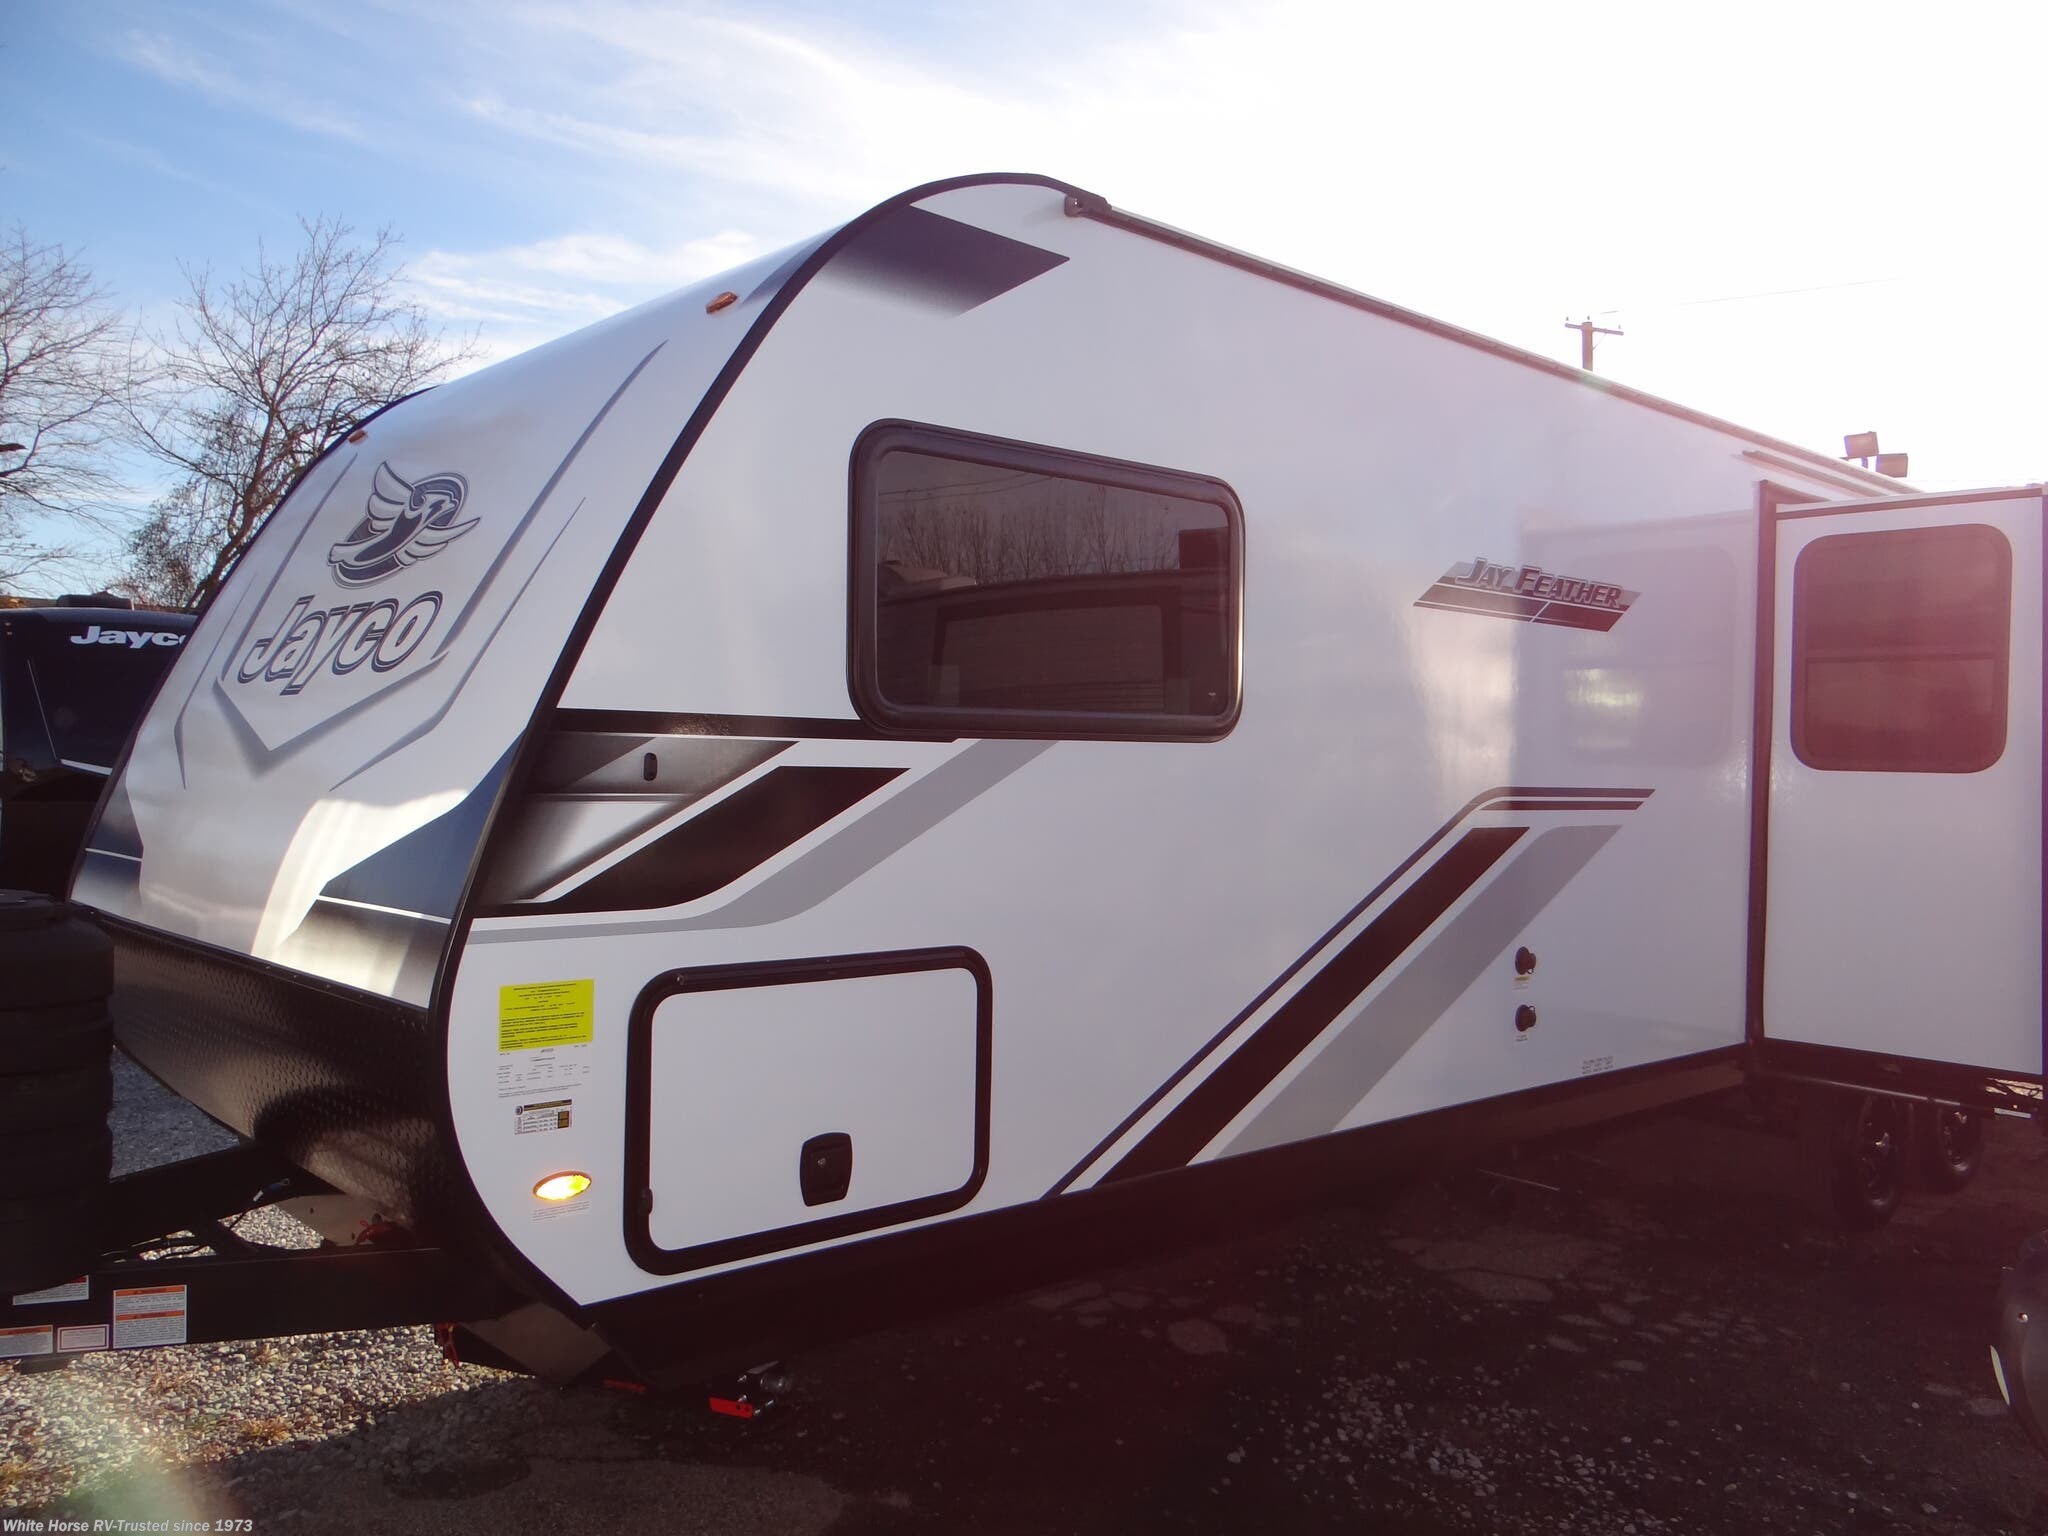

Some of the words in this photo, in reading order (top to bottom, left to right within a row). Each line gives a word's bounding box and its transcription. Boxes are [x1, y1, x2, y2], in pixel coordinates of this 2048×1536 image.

[1456, 558, 1514, 589] JAY
[1514, 565, 1624, 607] FEATHER
[237, 590, 443, 695] Jayco
